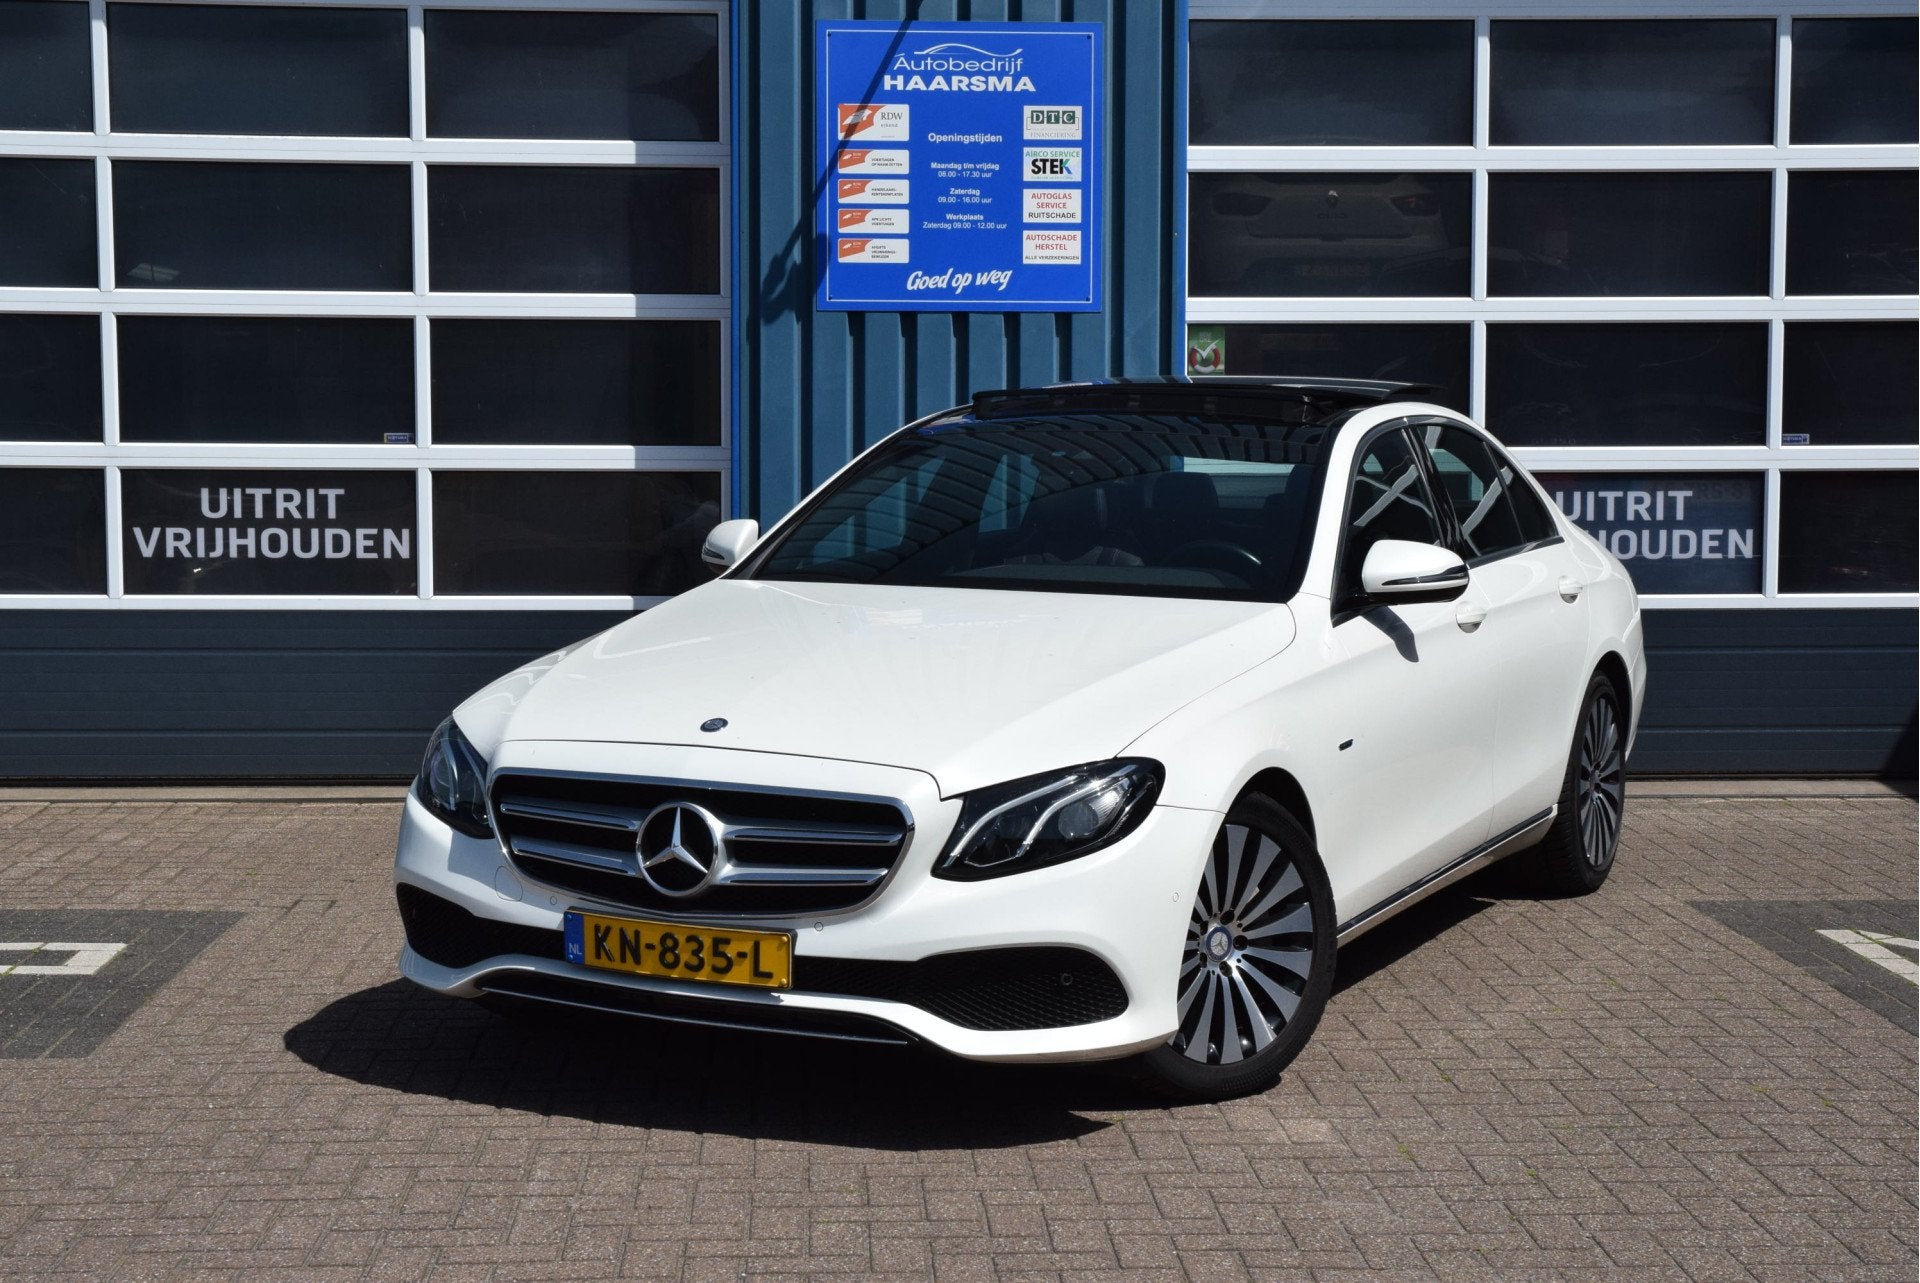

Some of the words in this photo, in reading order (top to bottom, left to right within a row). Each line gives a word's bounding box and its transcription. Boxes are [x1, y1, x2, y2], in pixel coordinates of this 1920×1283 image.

[893, 56, 1023, 75] Autobedrijf
[883, 75, 1036, 92] HAARSMA
[881, 112, 903, 121] RDW
[1032, 111, 1074, 124] DTC
[928, 132, 1003, 144] Openingstijden
[931, 162, 962, 170] Maandag
[976, 162, 1000, 170] vrijdag
[1031, 158, 1073, 175] STEK
[950, 188, 980, 196] Zaterdag
[945, 213, 984, 221] Werkplaats
[923, 222, 951, 230] Zaterdag
[906, 267, 954, 291] Goed
[951, 272, 972, 295] op
[975, 269, 1013, 291] weg
[200, 487, 345, 519] UITRIT
[1555, 490, 1693, 521] UITRIT
[133, 526, 410, 559] VRIJHOUDEN
[568, 943, 582, 955] NL
[593, 923, 774, 980] KN-835-L
